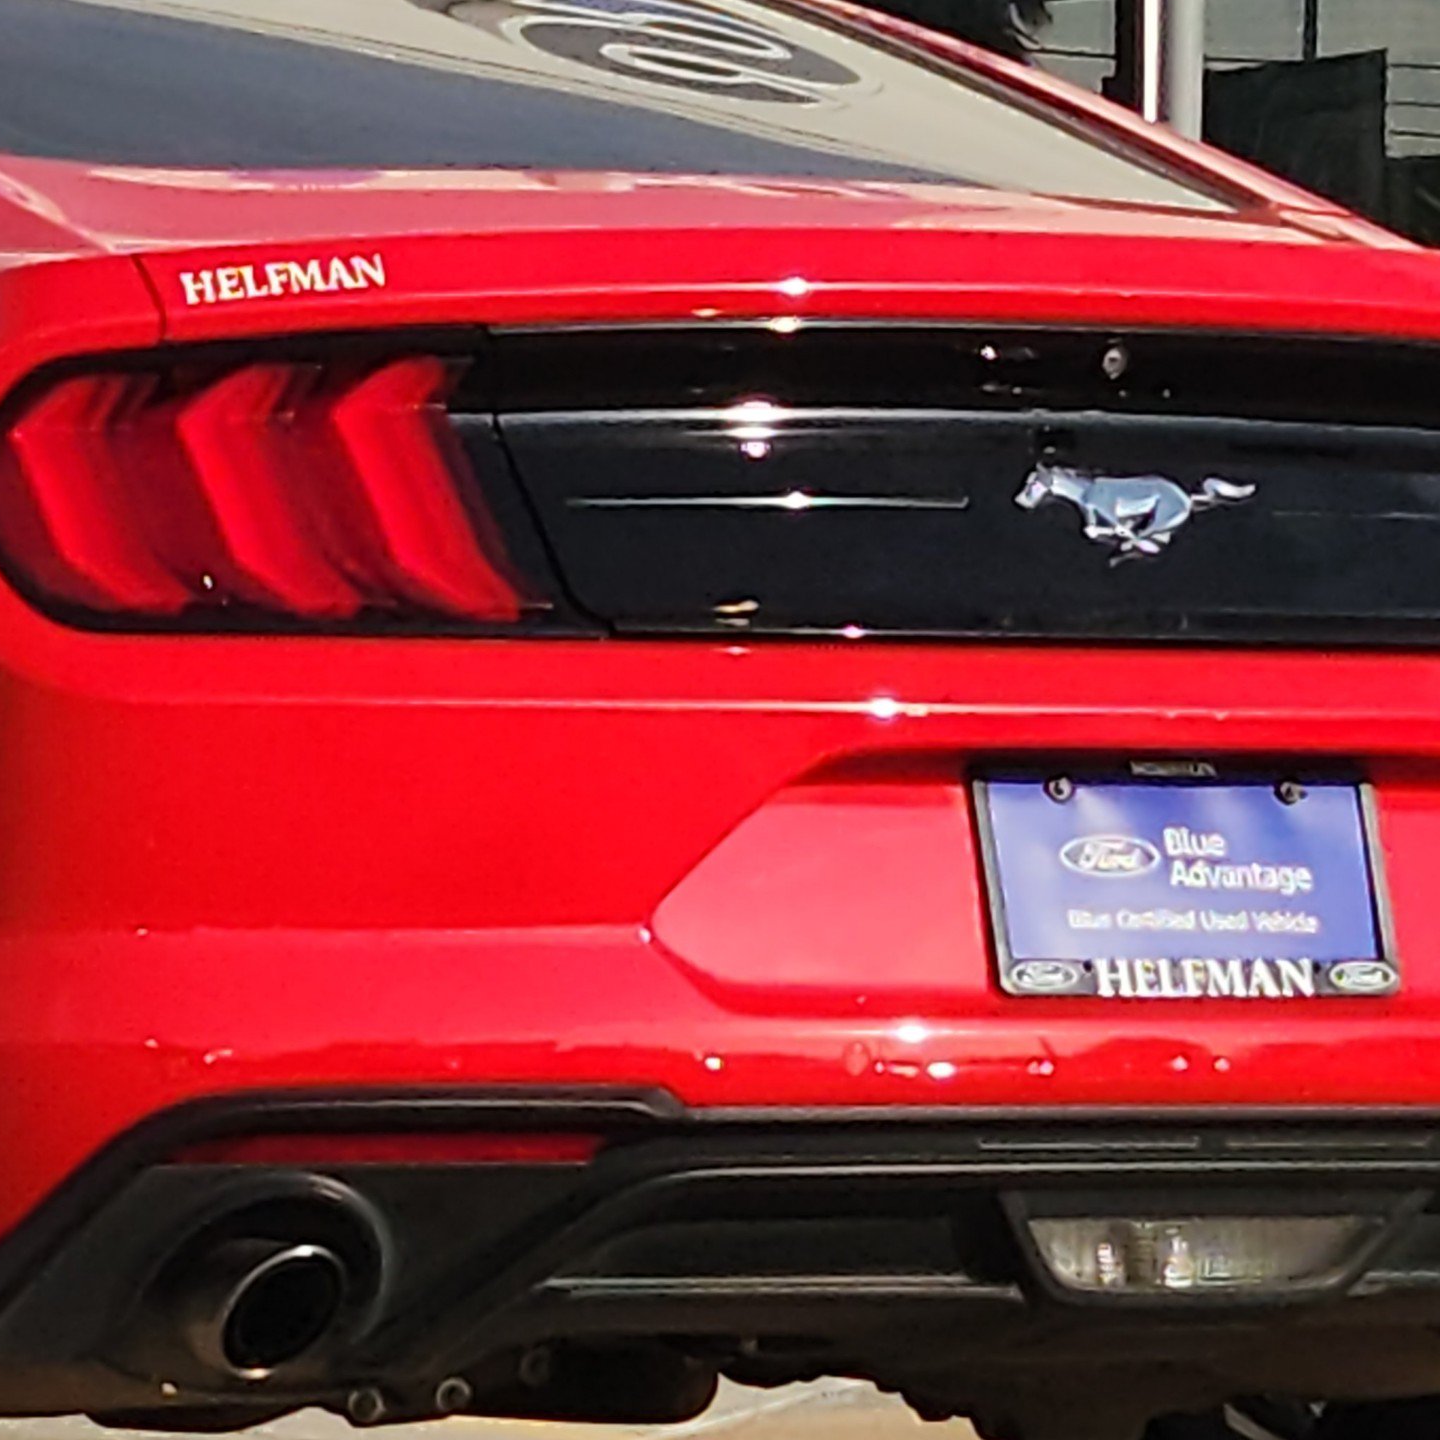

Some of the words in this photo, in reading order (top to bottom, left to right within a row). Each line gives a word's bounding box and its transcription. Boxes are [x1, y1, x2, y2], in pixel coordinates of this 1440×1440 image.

[179, 253, 385, 305] HELFMAN
[1163, 827, 1226, 857] Blue
[1170, 860, 1313, 895] Advantage
[1096, 958, 1315, 997] HELFMAN
